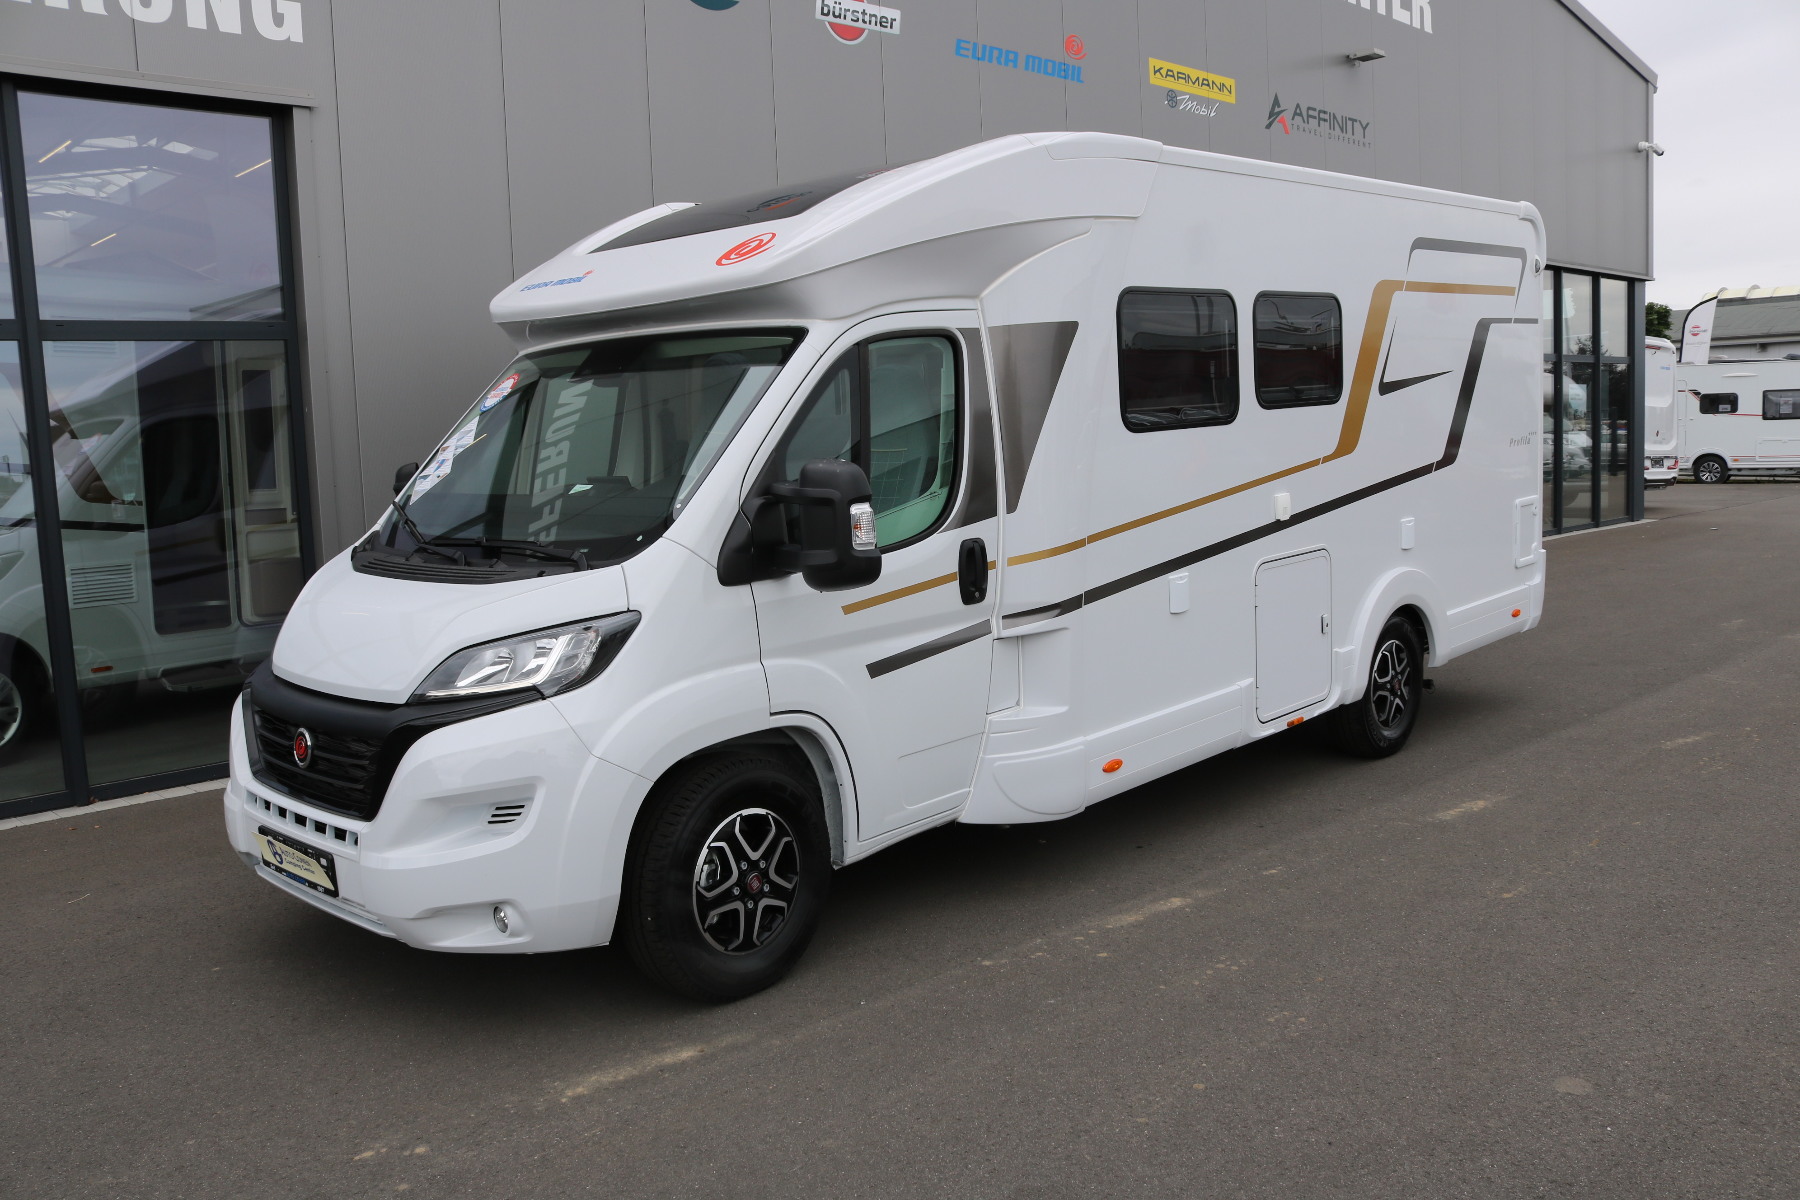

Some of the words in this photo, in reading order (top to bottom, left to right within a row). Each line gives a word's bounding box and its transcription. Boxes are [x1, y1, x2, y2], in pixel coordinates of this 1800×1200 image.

[820, 0, 897, 30] bürstner
[955, 38, 1019, 69] EURA
[1023, 54, 1085, 84] MOBIL
[1153, 65, 1232, 95] KARMANN
[1176, 94, 1220, 117] Mobil
[1291, 102, 1370, 139] AFFINITY
[1291, 123, 1323, 138] TRAVEL
[1328, 132, 1372, 149] DIFFERENT
